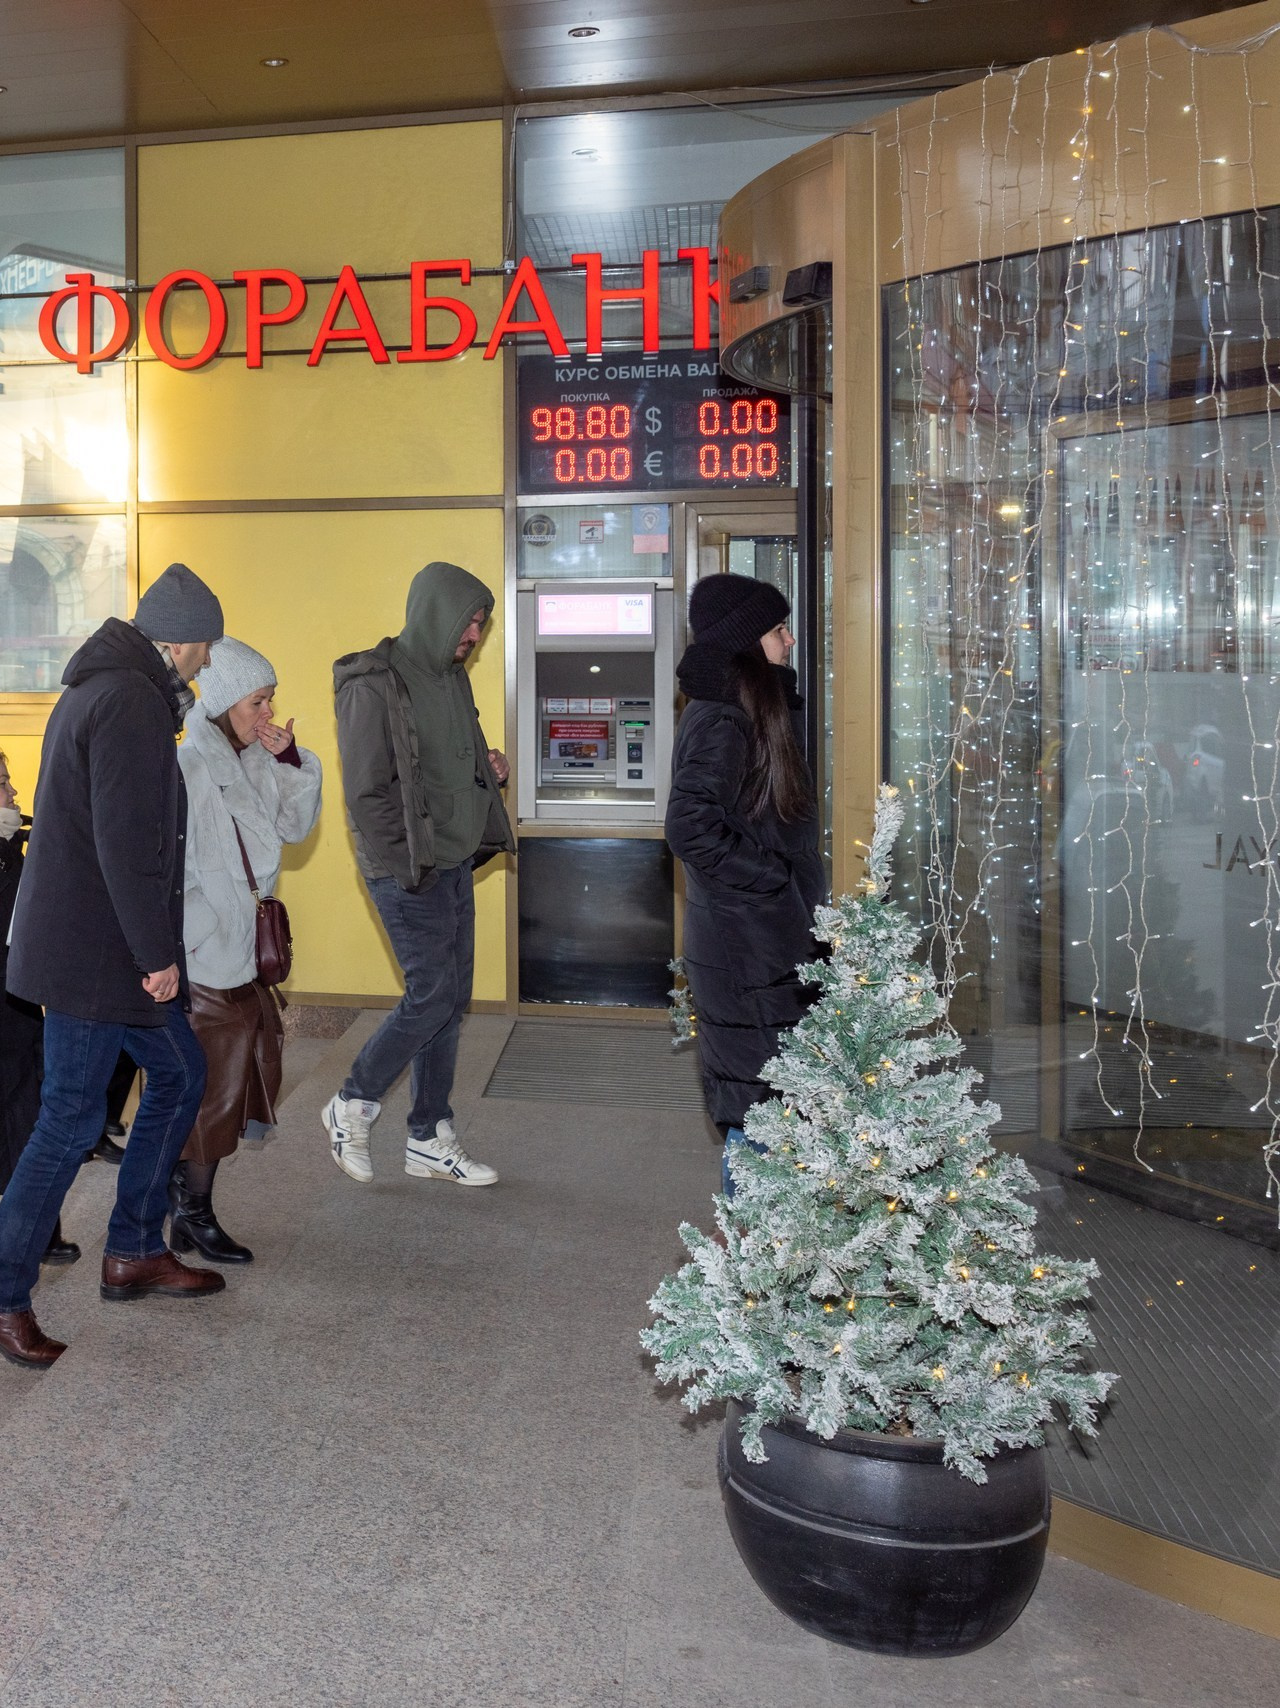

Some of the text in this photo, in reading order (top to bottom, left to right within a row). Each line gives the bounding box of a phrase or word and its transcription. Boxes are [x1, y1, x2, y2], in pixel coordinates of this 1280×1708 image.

[38, 247, 719, 376] ФОРАБАНК
[555, 366, 599, 382] КУРС
[605, 364, 682, 380] ОБМЕНА
[560, 386, 759, 403] ПОКУПКА ПРОДАЖА
[532, 405, 631, 441] 98.80
[699, 399, 778, 436] 0.00
[555, 447, 631, 483] 0.00
[699, 442, 778, 479] 0.00
